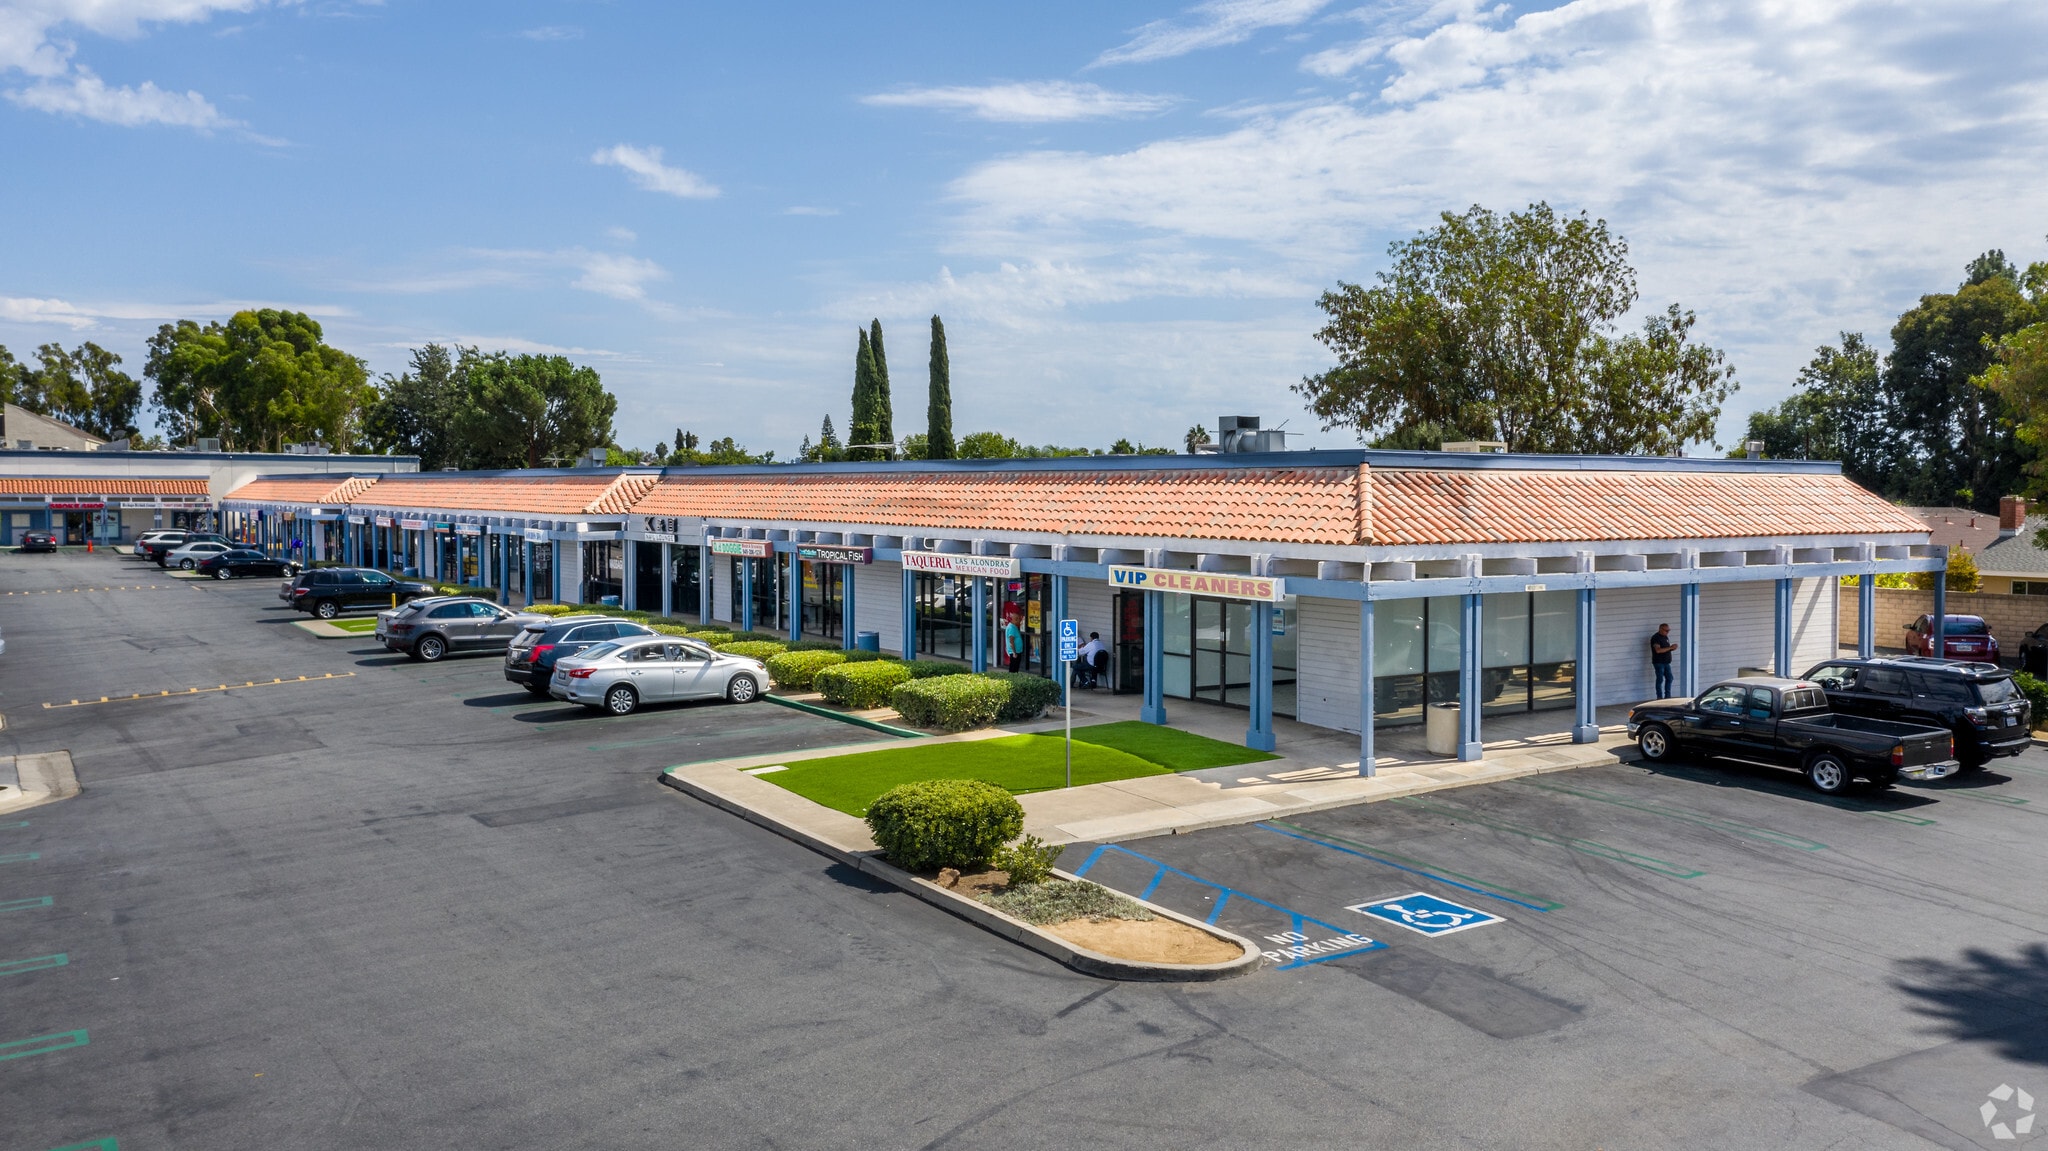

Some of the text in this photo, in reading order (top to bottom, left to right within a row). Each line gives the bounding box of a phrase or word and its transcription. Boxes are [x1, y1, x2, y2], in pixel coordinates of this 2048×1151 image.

[817, 549, 848, 560] TROPICAL
[848, 551, 864, 561] FISH
[904, 554, 952, 569] TAQUERIA
[955, 565, 987, 573] MEXICAN
[971, 559, 1010, 568] ALONDRAS
[1113, 569, 1272, 598] VIP CLEANERS
[1263, 931, 1309, 945] NO
[1261, 933, 1374, 962] PARKING
